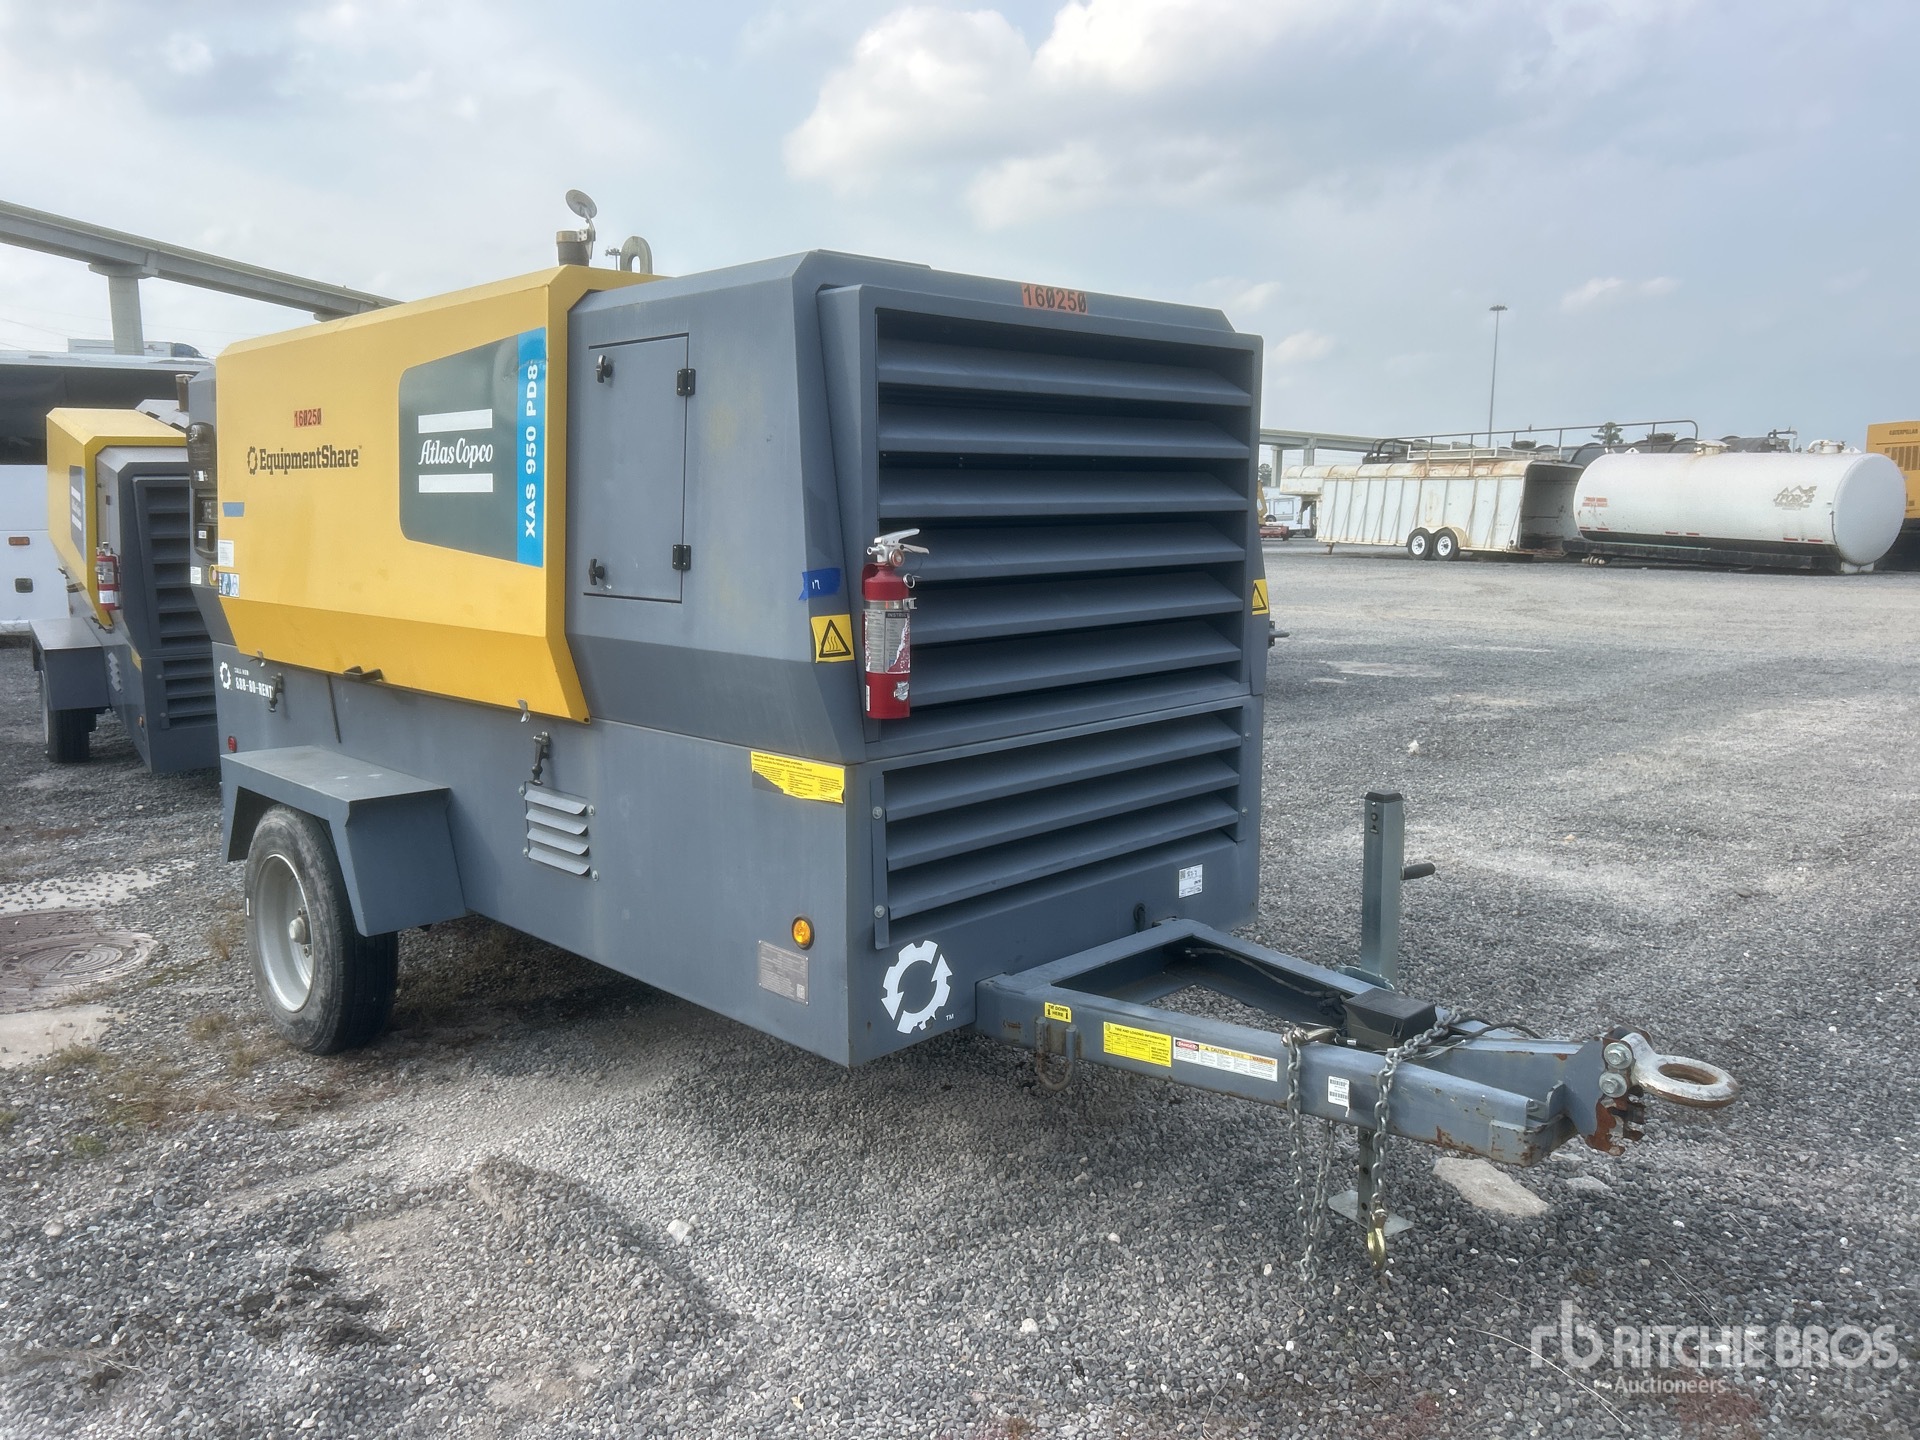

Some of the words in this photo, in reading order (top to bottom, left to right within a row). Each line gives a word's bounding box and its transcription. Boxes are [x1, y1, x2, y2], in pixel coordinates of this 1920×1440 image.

[1023, 284, 1087, 313] 160250
[526, 364, 538, 416] PD8
[293, 408, 322, 427] 160250
[259, 444, 359, 475] EquipmentShare
[418, 439, 454, 466] Atlas
[455, 437, 493, 469] Copco
[525, 426, 537, 474] 950
[525, 483, 536, 538] XAS
